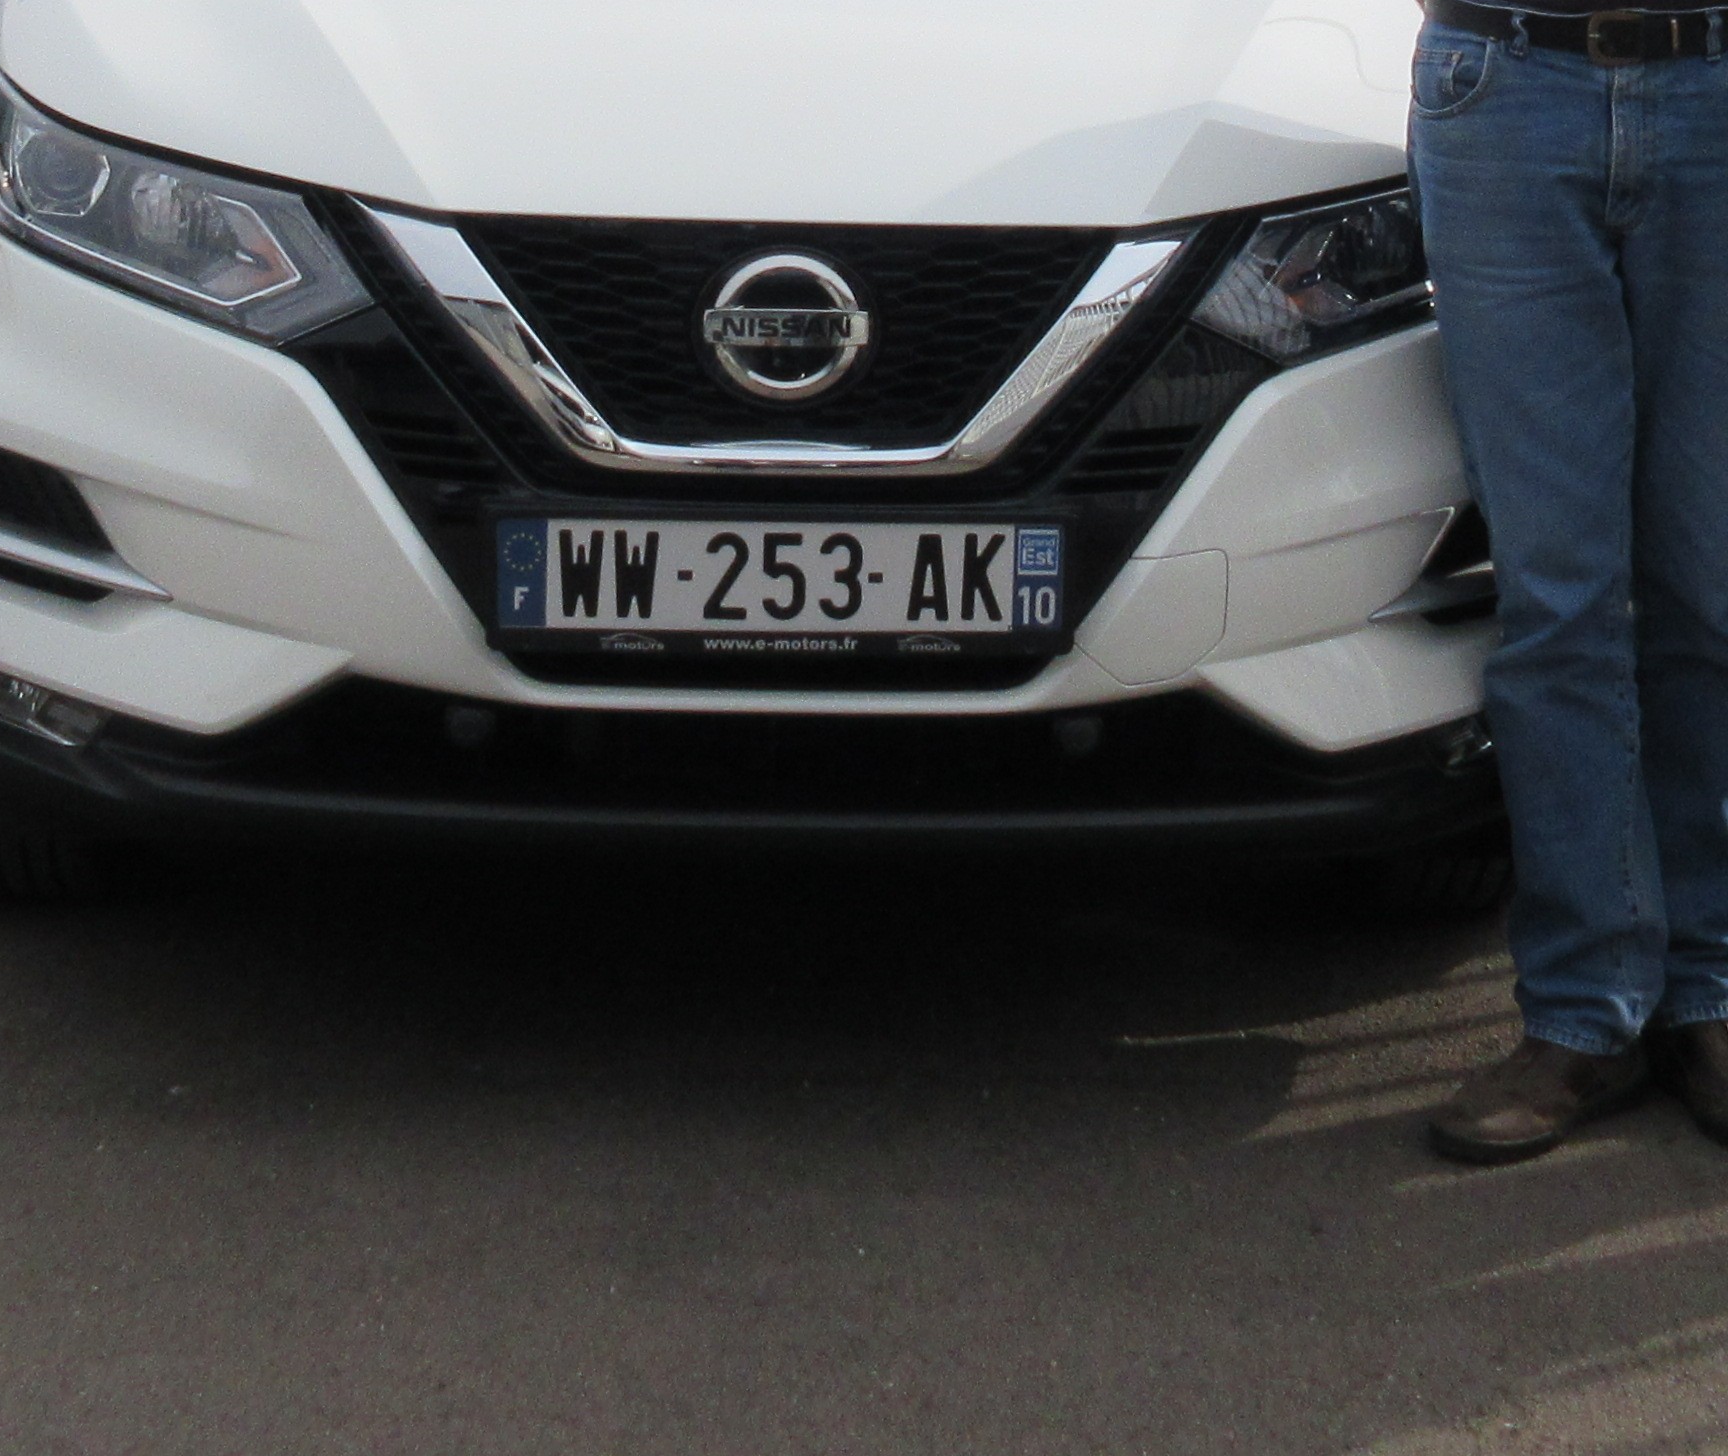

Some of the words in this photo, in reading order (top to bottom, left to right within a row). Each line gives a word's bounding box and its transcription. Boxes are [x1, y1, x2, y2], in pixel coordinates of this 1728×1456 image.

[721, 316, 852, 339] NISSAN
[1022, 547, 1055, 566] Est
[514, 586, 529, 611] F
[1018, 586, 1056, 624] 10
[703, 636, 859, 651] www.e-motors.fr
